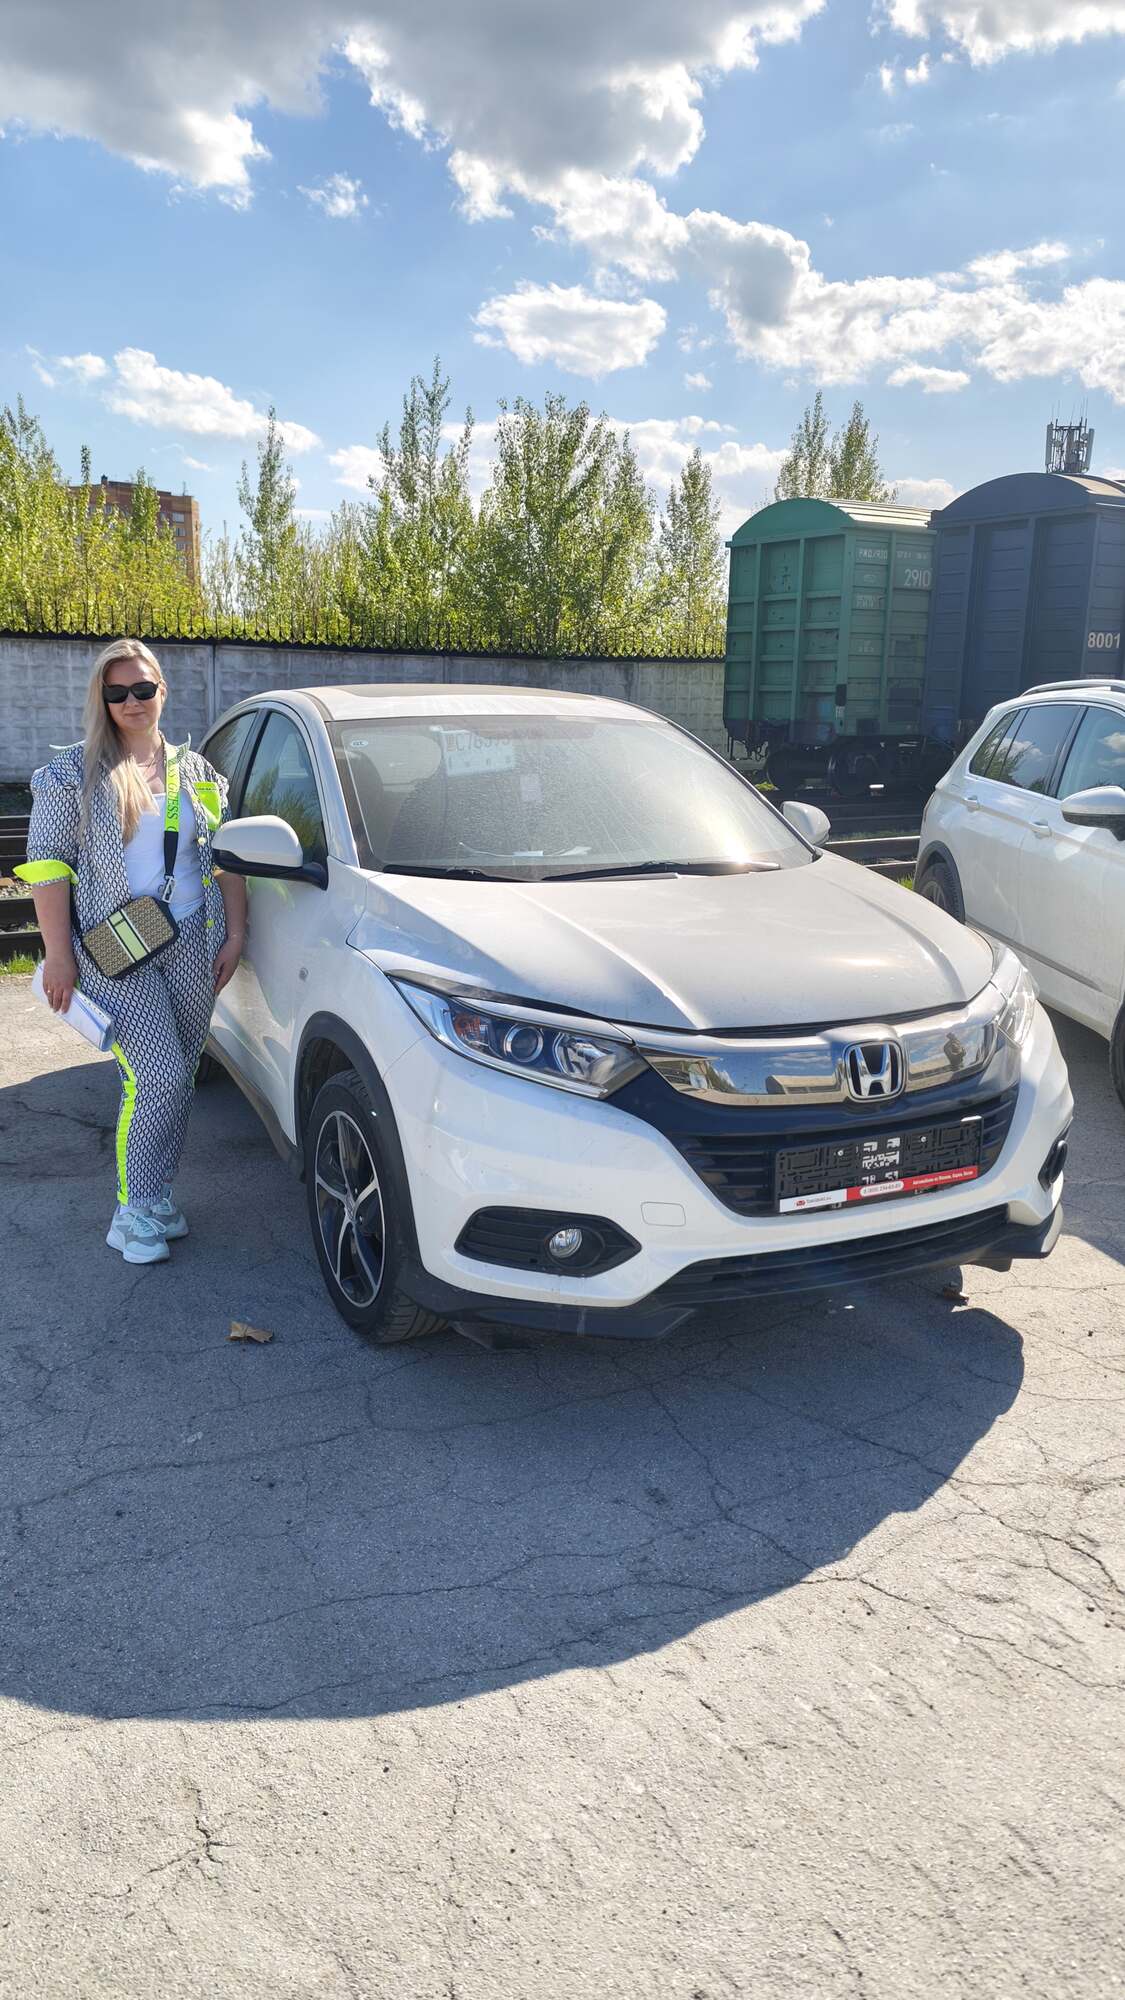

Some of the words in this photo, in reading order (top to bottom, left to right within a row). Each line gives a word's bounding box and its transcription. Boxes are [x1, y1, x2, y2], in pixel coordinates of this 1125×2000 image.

[904, 568, 932, 588] 2910
[1088, 632, 1120, 649] 8001
[166, 782, 179, 820] GUESS
